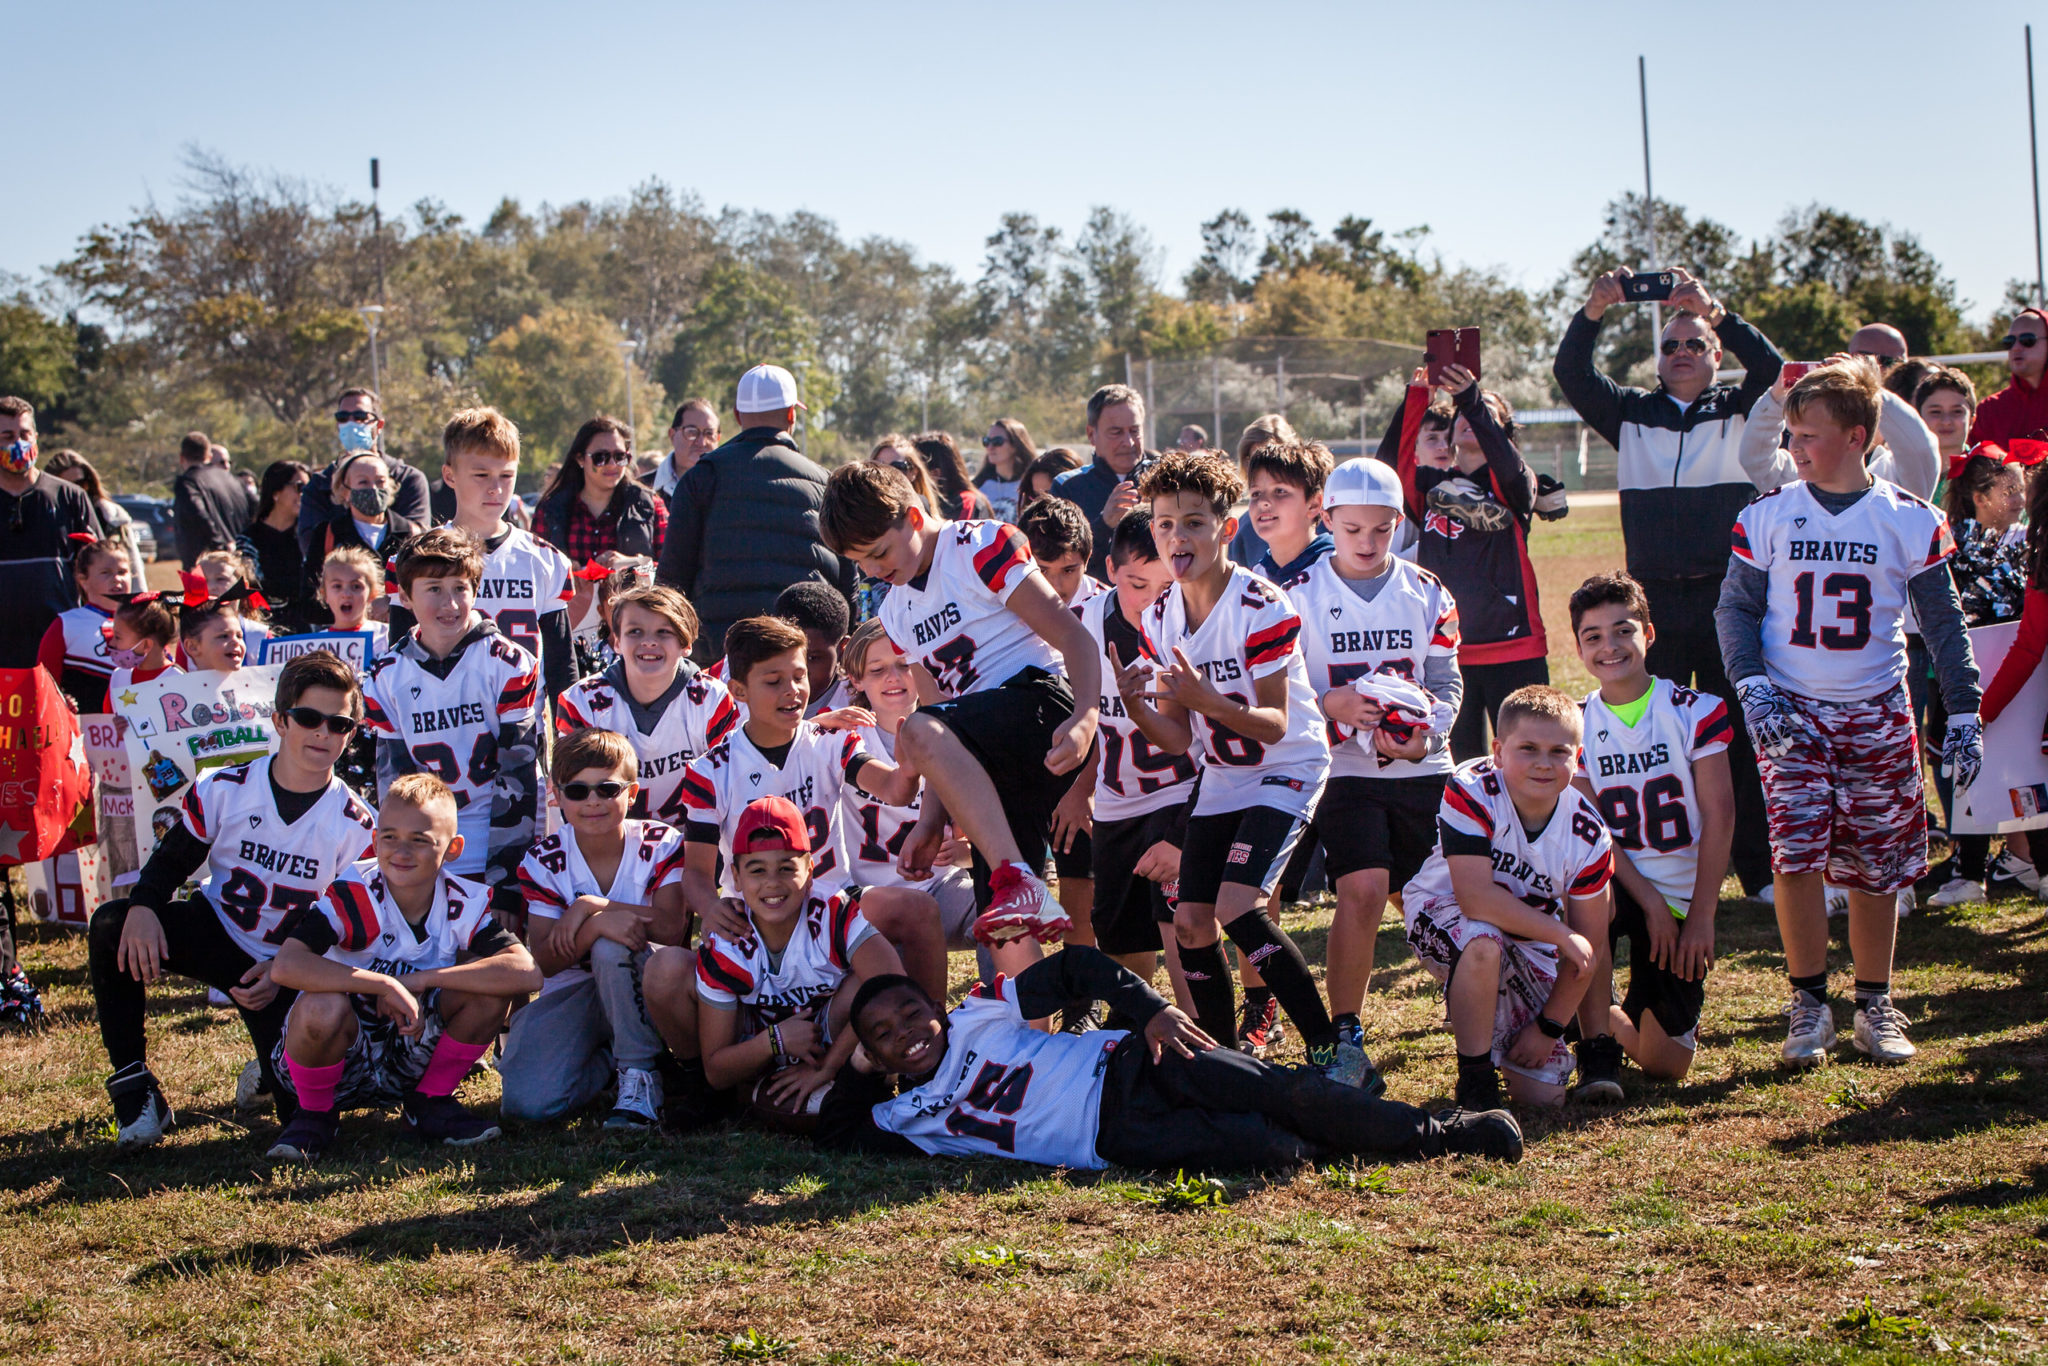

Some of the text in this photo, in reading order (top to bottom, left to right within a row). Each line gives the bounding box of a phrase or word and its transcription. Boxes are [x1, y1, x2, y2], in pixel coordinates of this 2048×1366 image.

[1789, 541, 1878, 565] BRAVES
[476, 578, 534, 599] AVES
[1788, 571, 1874, 651] 13
[472, 608, 540, 660] 6
[1330, 629, 1413, 654] BRAVES
[1197, 657, 1242, 683] VES
[411, 702, 485, 734] BRAVES
[411, 732, 499, 810] 24
[637, 749, 694, 779] AVES
[1598, 742, 1670, 778] BRAVES
[1597, 773, 1695, 854] 96
[239, 839, 320, 880] BRAVES
[1490, 847, 1554, 893] BRAVES
[220, 866, 320, 946] 97
